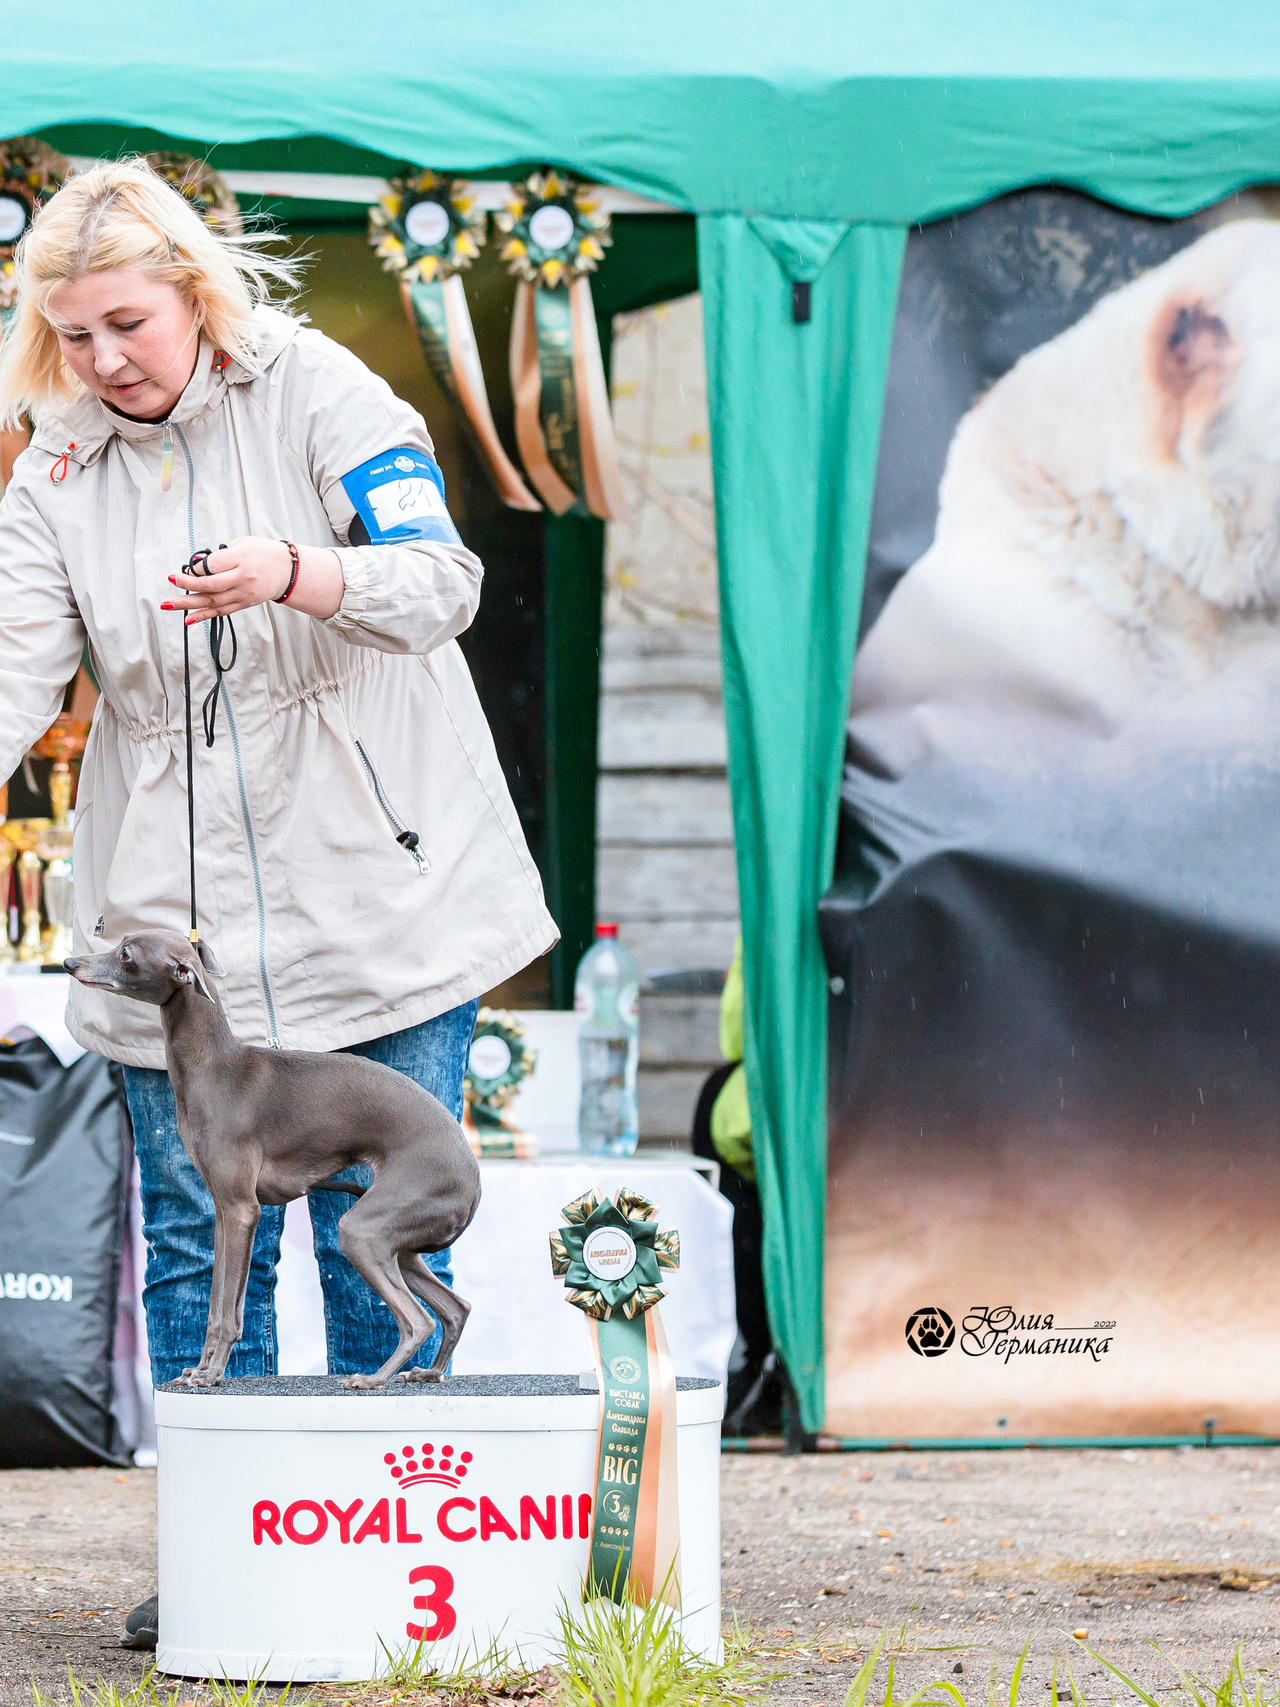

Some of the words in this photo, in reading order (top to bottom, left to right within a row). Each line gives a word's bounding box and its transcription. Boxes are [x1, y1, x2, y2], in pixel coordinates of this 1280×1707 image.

[609, 1389, 645, 1401] ВЫСТАВКА
[615, 1399, 640, 1409] СОБАК
[602, 1455, 638, 1485] BIG
[609, 1494, 621, 1513] 3
[253, 1497, 423, 1545] ROYAL
[406, 1565, 457, 1642] 3
